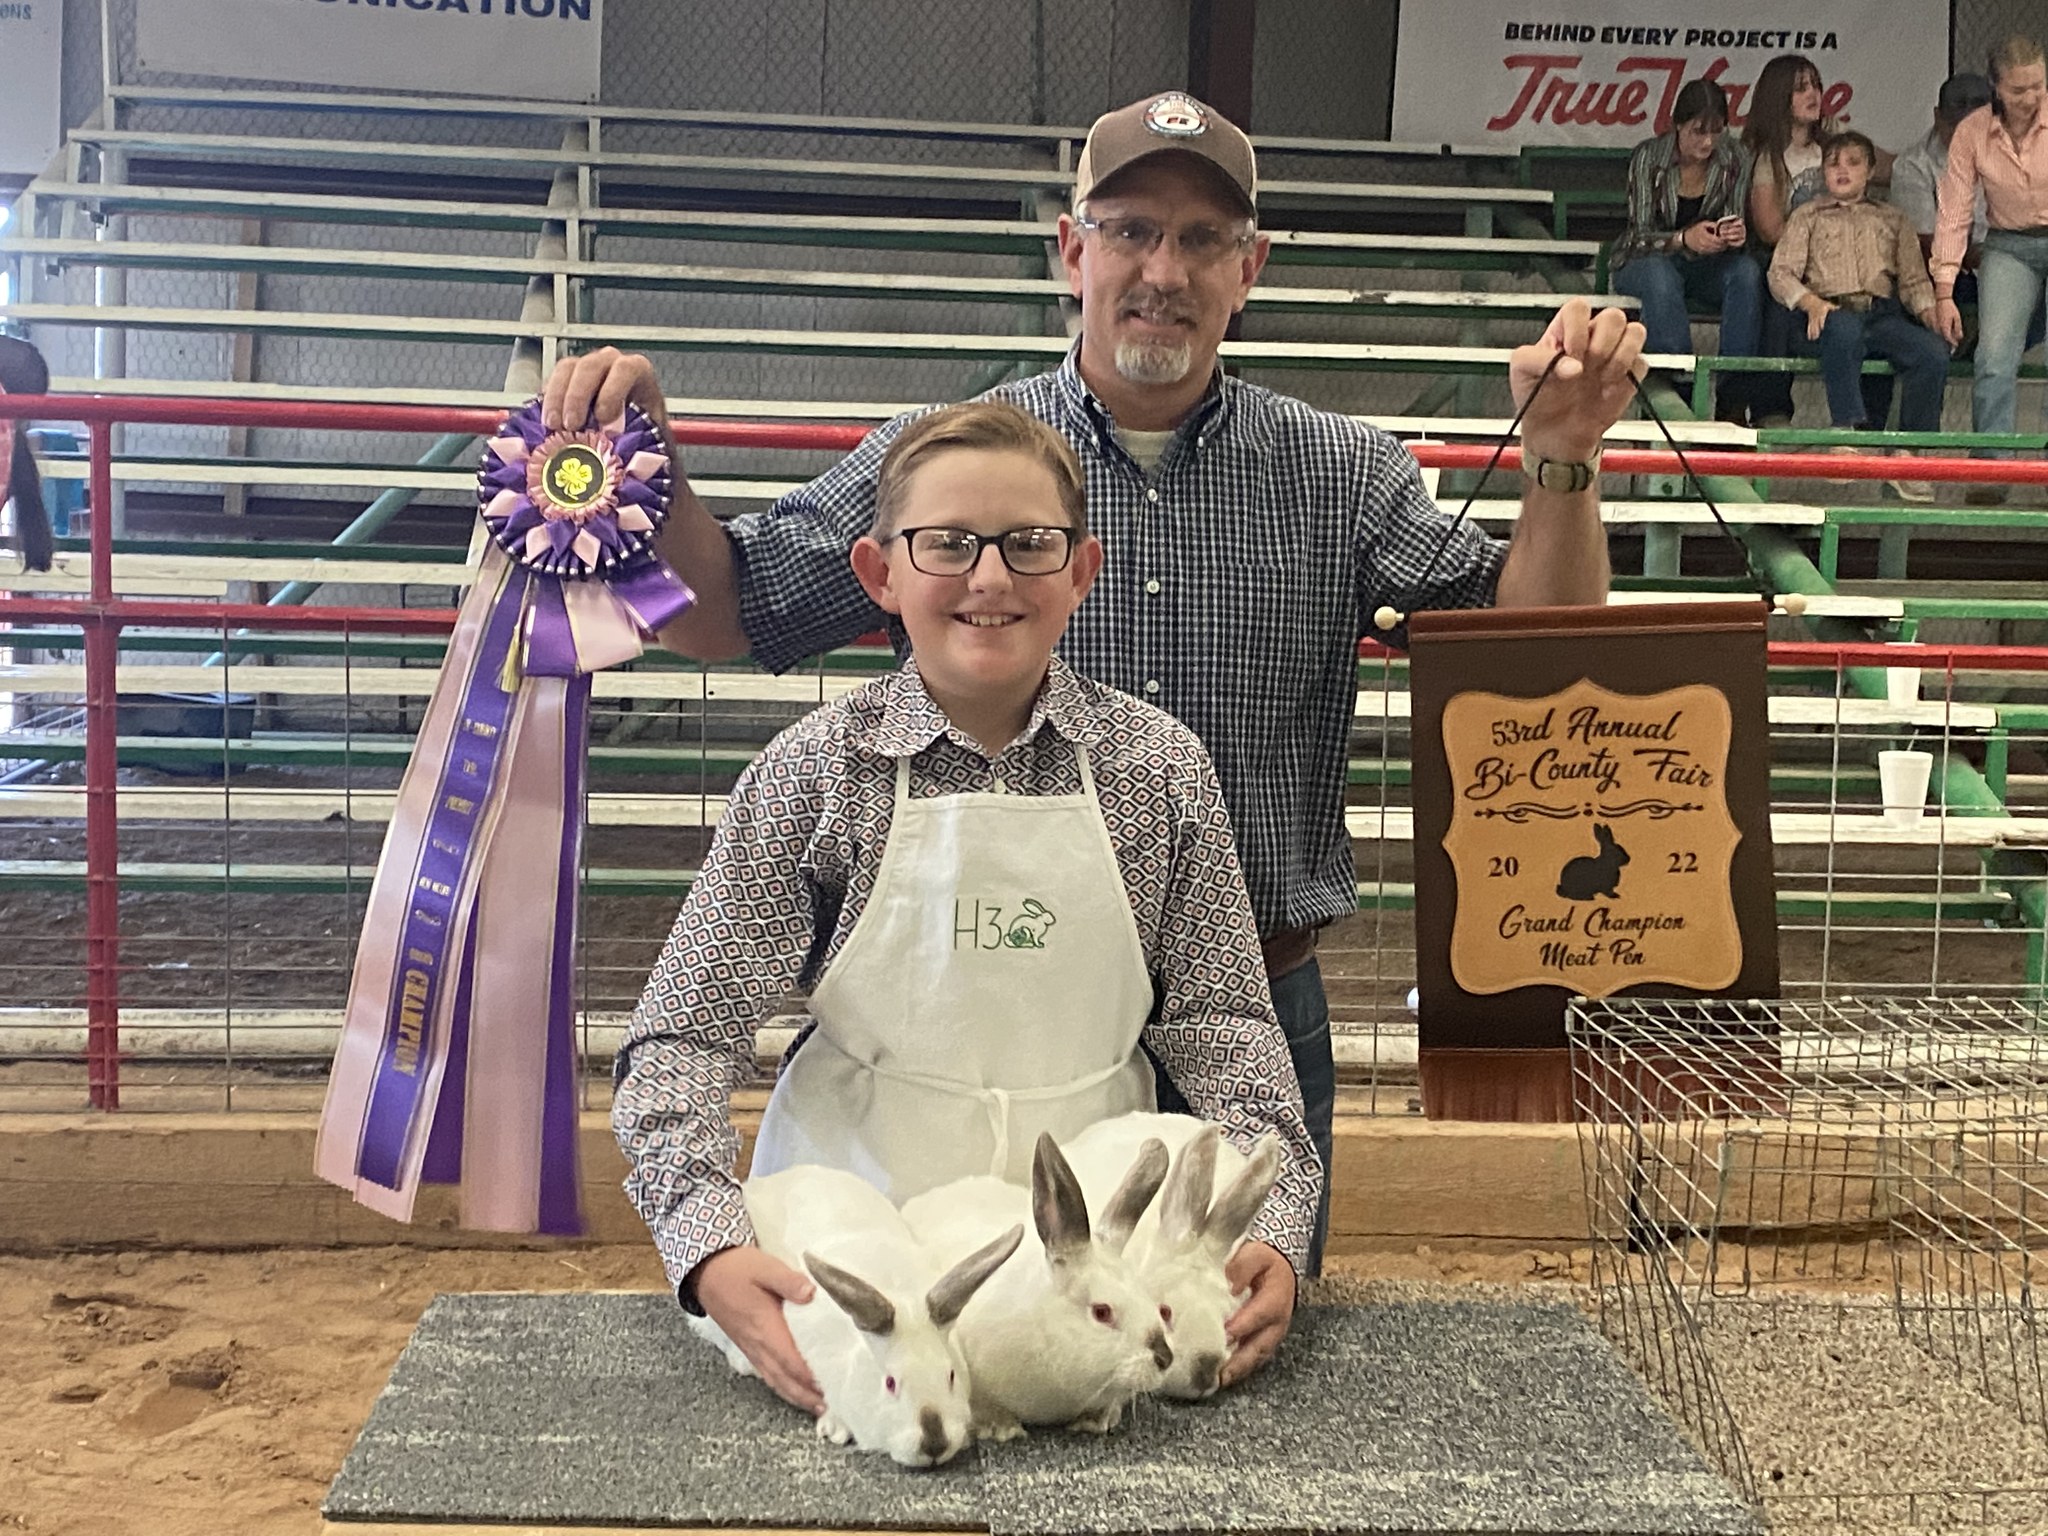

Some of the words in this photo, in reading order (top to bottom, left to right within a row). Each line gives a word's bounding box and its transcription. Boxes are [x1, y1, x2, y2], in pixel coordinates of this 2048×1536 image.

[1504, 22, 1595, 43] BEHIND
[1600, 26, 1679, 46] EVERY
[1684, 29, 1791, 49] PROJECT
[1795, 31, 1817, 49] IS
[1820, 32, 1838, 50] A
[1486, 54, 1650, 131] True
[1491, 708, 1555, 747] 53rd
[1567, 706, 1684, 746] Annual
[1463, 748, 1622, 801] Bi-County
[1633, 748, 1714, 788] Fair
[1488, 856, 1520, 878] 20
[1667, 852, 1699, 874] 22
[1499, 904, 1576, 940] Grand
[1583, 906, 1686, 940] Champion
[1540, 942, 1604, 972] Meat
[1609, 938, 1646, 966] Pen
